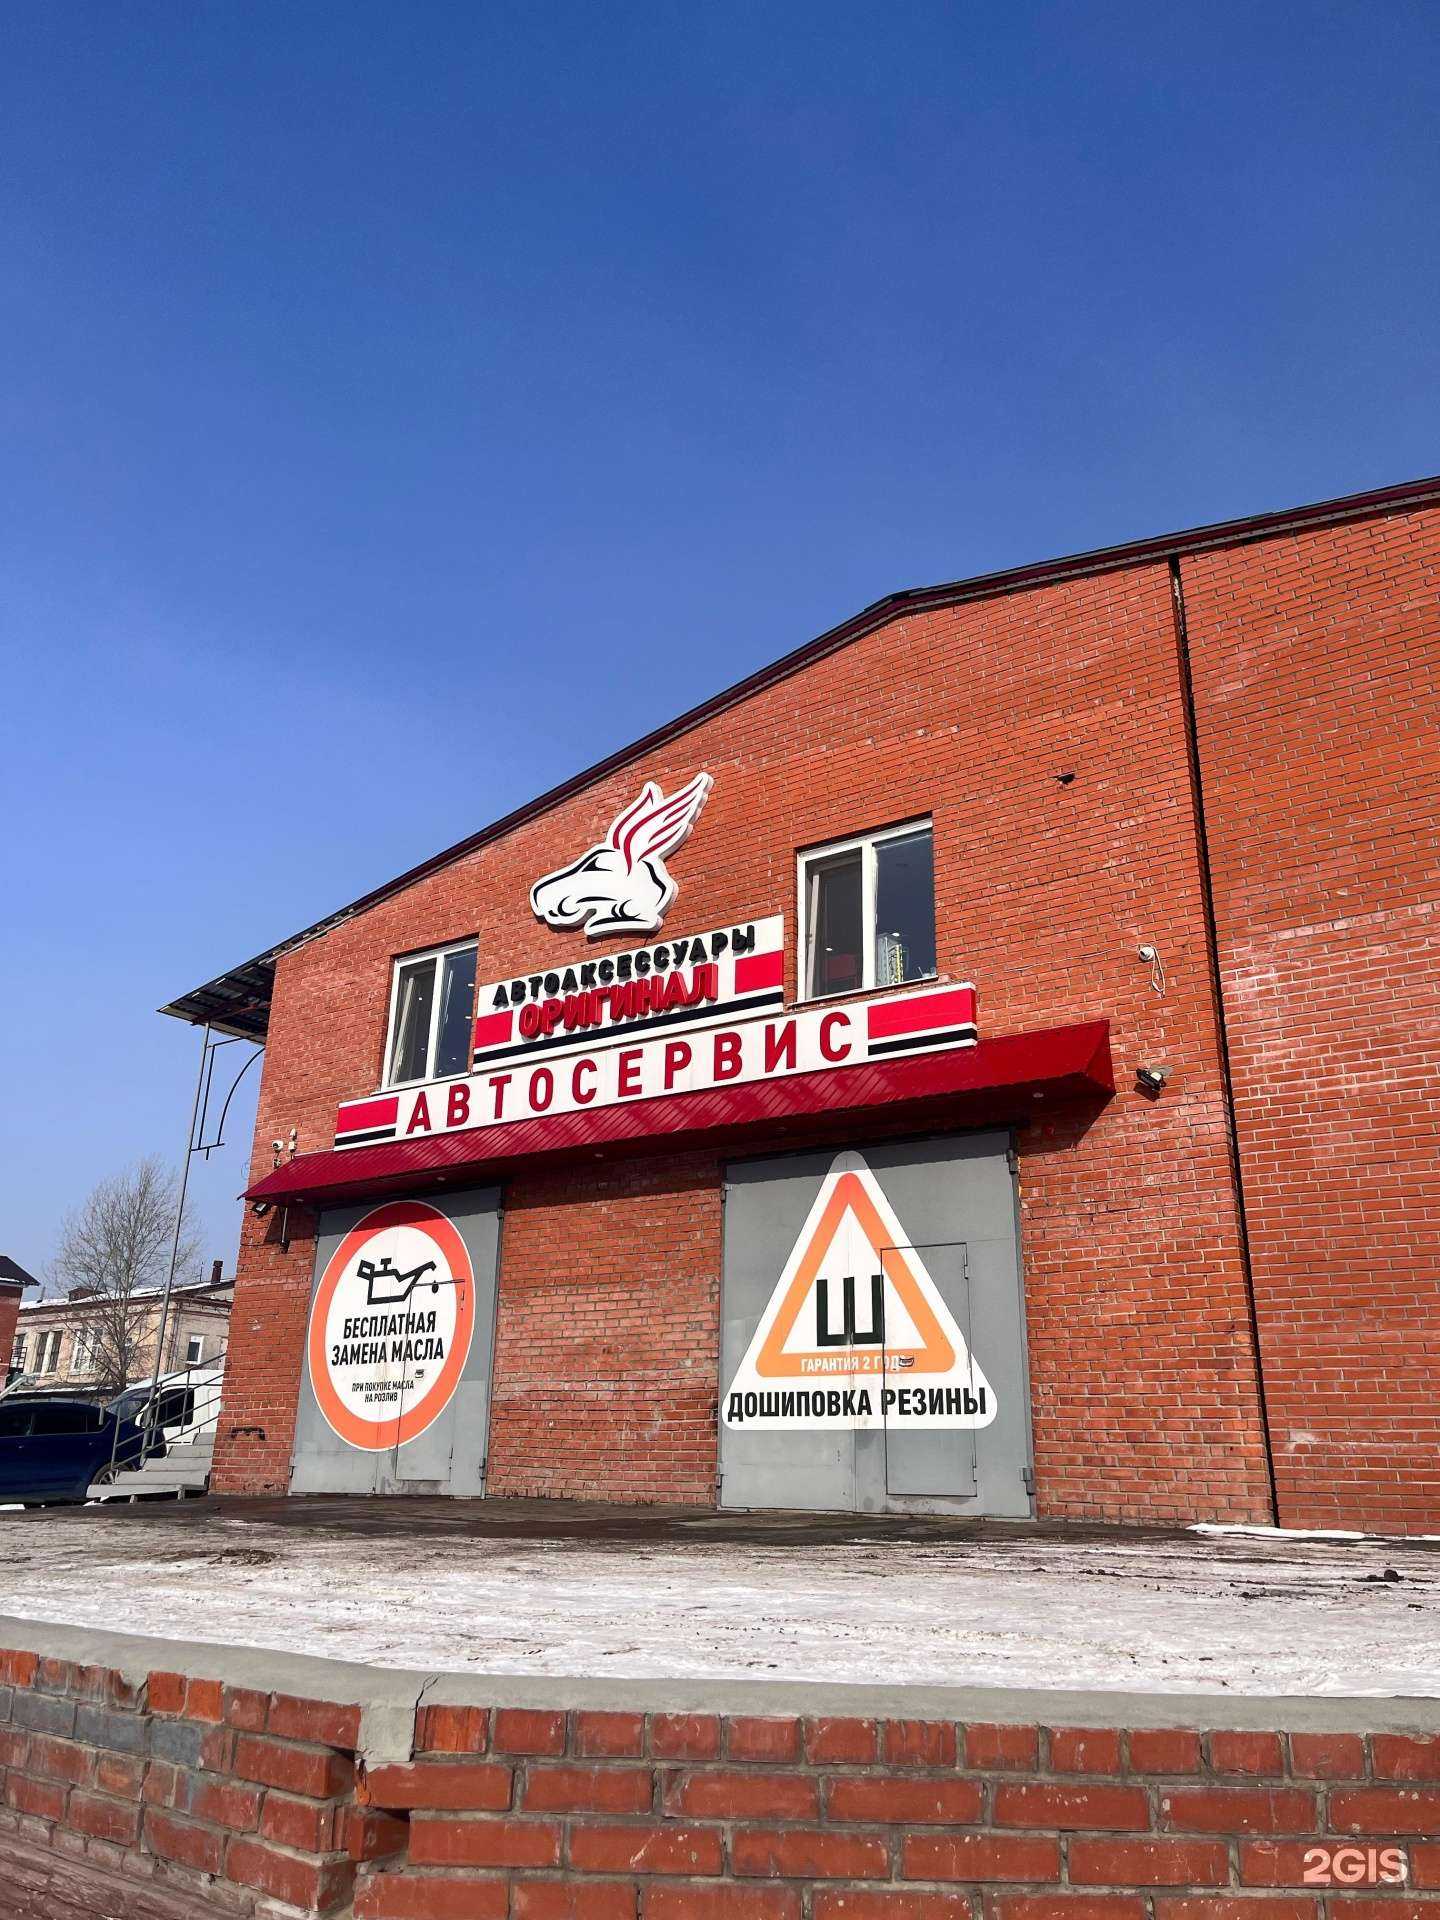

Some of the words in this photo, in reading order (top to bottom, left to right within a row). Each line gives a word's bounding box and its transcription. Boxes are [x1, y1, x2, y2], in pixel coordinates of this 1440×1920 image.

[492, 924, 756, 1007] АВТОАКСЕССУАРЫ
[518, 963, 719, 1039] ОРИГИНАЛ
[406, 1011, 853, 1134] АВТОСЕРВИС
[343, 1310, 437, 1339] БЕСПЛАТНАЯ
[816, 1275, 885, 1347] Ш
[331, 1341, 388, 1366] ЗАМЕНА
[391, 1337, 444, 1362] МАСЛА
[801, 1356, 860, 1373] ГАРАНТИЯ
[863, 1356, 871, 1370] 2
[352, 1382, 364, 1393] ПРИ
[364, 1380, 392, 1392] ПОКУПКЕ
[392, 1379, 415, 1391] МАСЛА
[364, 1393, 373, 1403] НА
[374, 1391, 398, 1402] РОЗЛИВ
[727, 1389, 873, 1423] ДОШИПОВКА
[881, 1387, 987, 1416] РЕЗИНЫ
